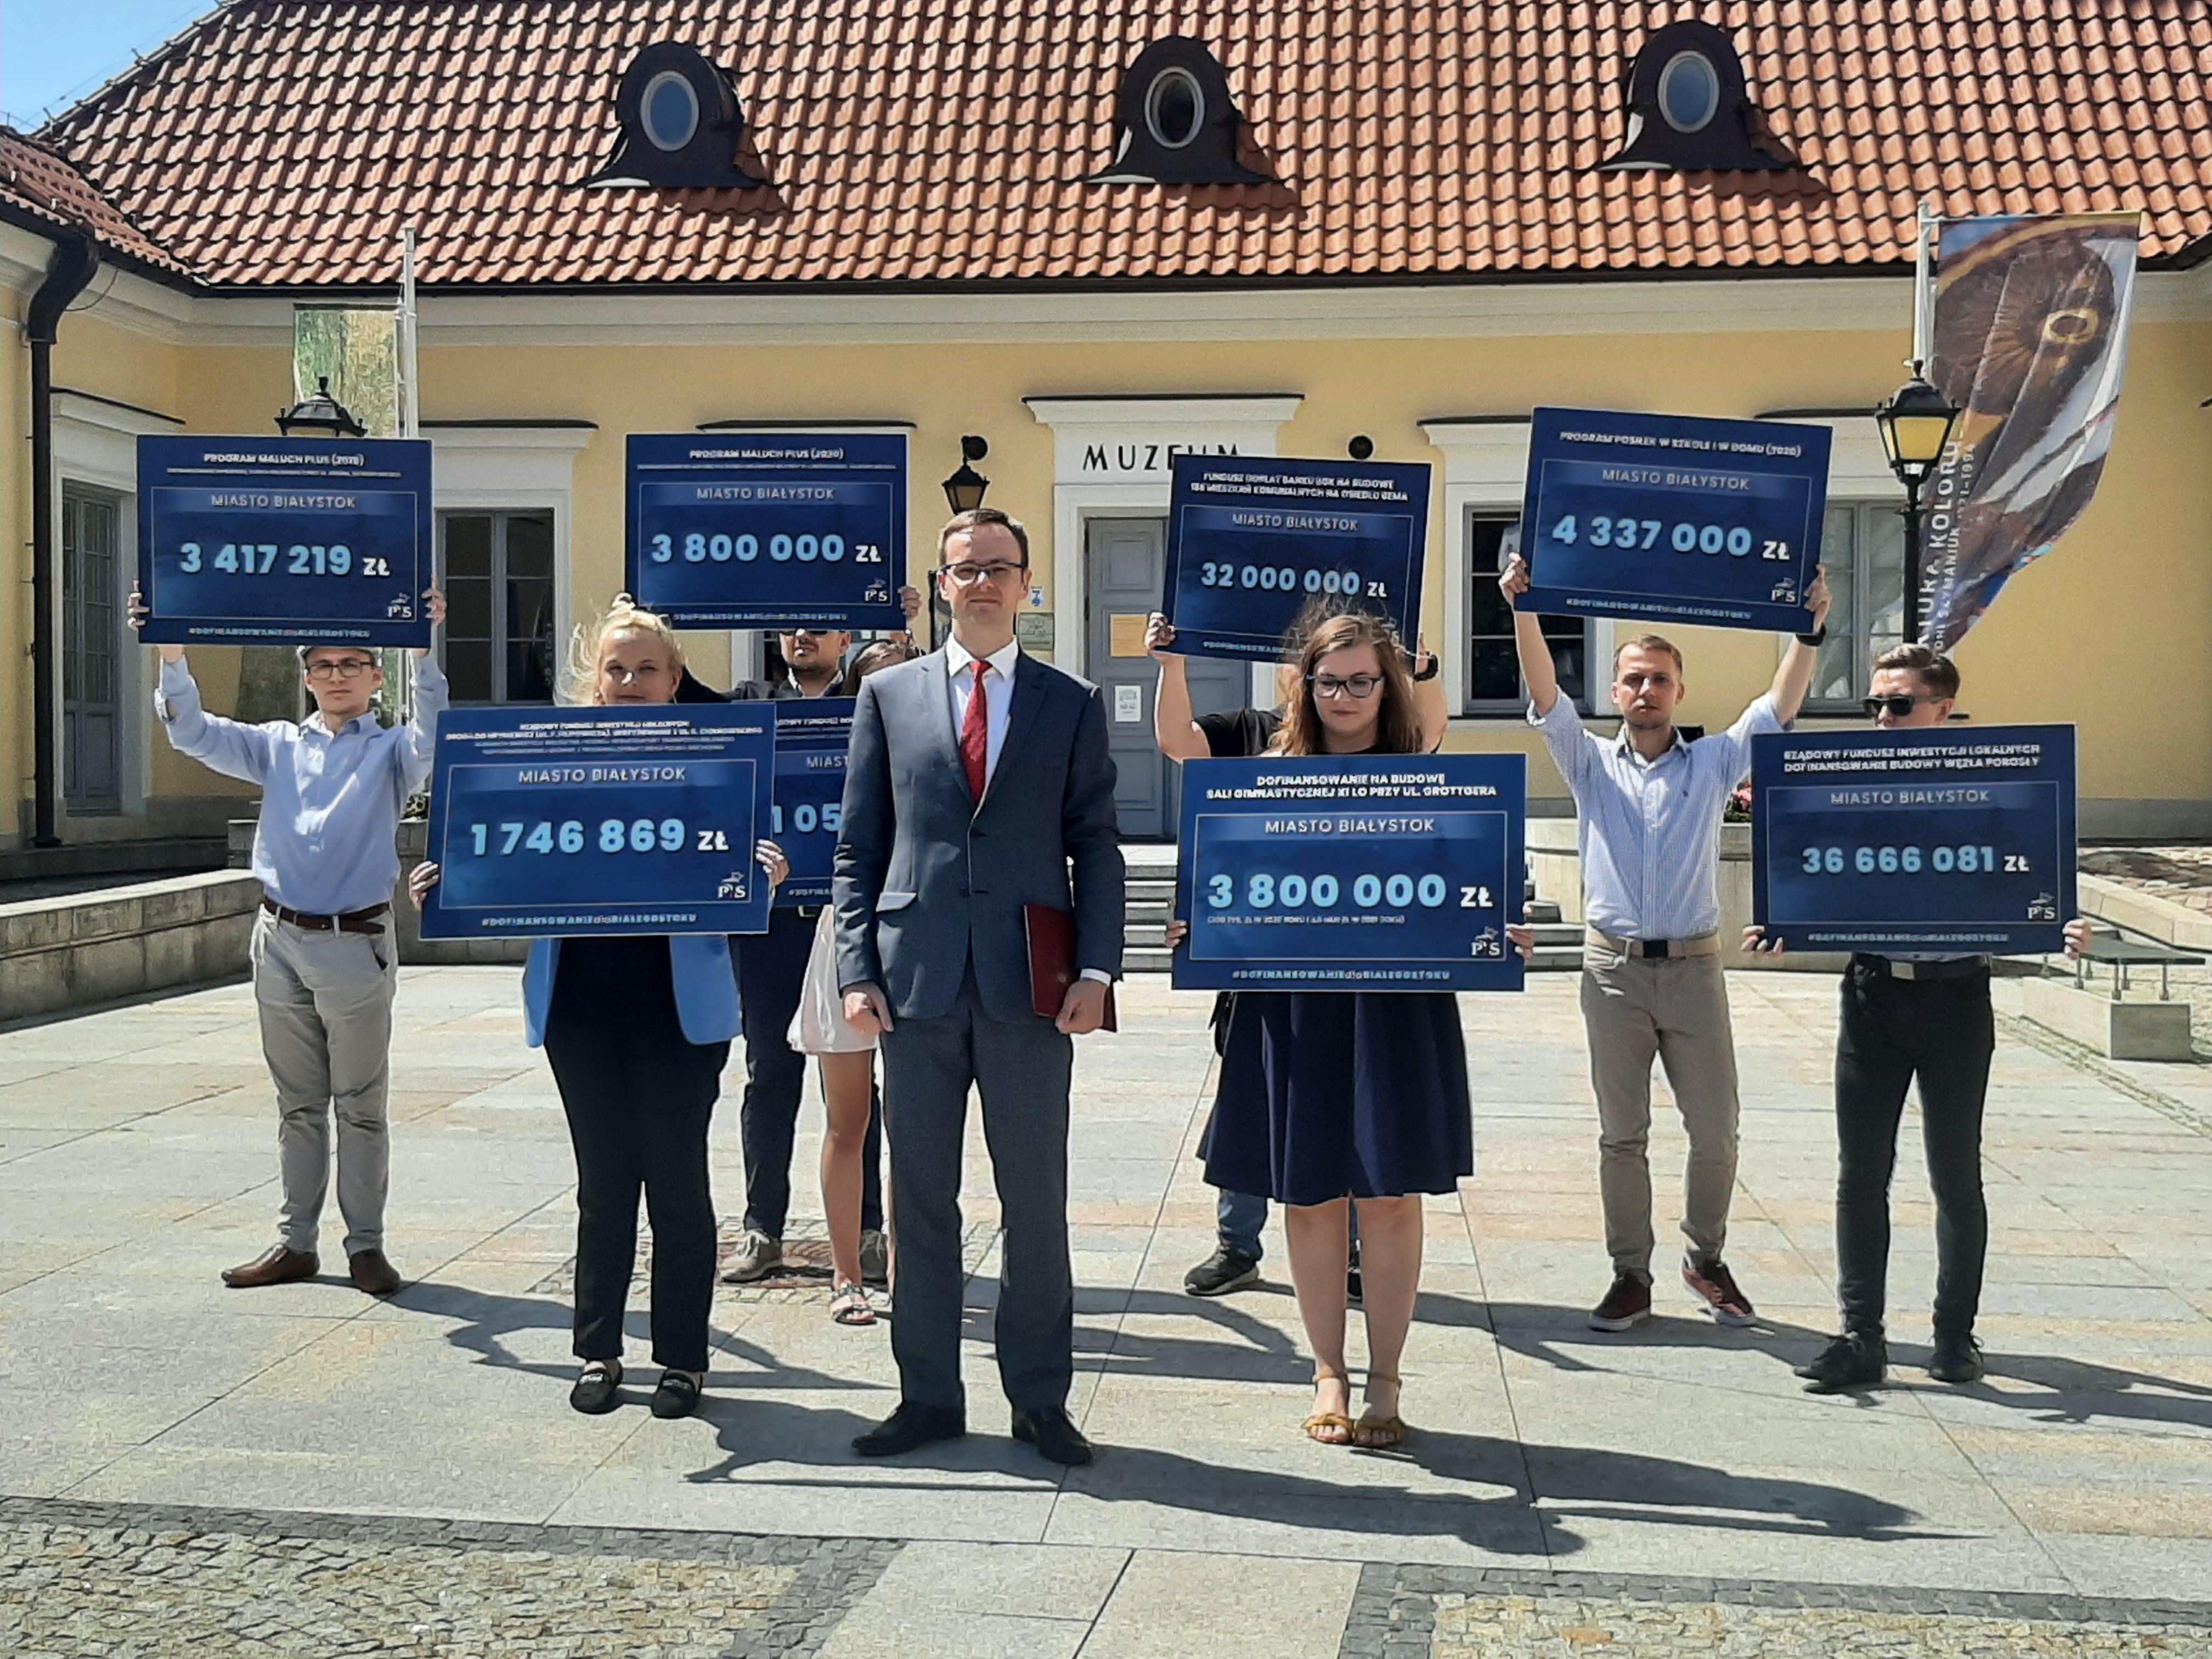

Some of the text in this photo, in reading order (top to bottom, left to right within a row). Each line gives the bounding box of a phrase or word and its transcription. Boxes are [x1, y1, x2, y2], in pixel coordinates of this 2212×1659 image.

[1560, 431, 1613, 443] PROGRAM
[1659, 438, 1670, 447] W
[1718, 441, 1729, 450] W
[1731, 443, 1764, 454] DOMU
[204, 453, 256, 463] PROGRAM
[690, 449, 740, 459] PROGRAM
[1602, 468, 1750, 490] MIASTO BIAŁYSTOK
[211, 494, 356, 509] MIASTO BIAŁYSTOK
[697, 487, 837, 500] MIASTO BIAŁYSTOK
[1928, 442, 1961, 548] KOLORU
[1231, 513, 1359, 532] MIASTO BIAŁYSTOK
[1552, 515, 1577, 544] 4
[1590, 516, 1662, 549] 337
[1672, 523, 1752, 556] 000
[652, 534, 672, 562] 3
[685, 534, 759, 562] 800
[770, 534, 845, 562] 000
[180, 543, 202, 573] 3
[214, 544, 278, 574] 417
[289, 545, 352, 575] 219
[1200, 562, 1234, 588] 32
[1241, 565, 1296, 591] 000
[1304, 569, 1360, 595] 000
[1784, 750, 1840, 761] RZĄDOWY
[1843, 748, 1895, 759] FUNDUSZ
[1968, 744, 2040, 755] LOKALNYCH
[806, 756, 849, 768] MIAST
[1890, 759, 1941, 769] BUDOWY
[518, 766, 686, 783] MIASTO BIAŁYSTOK
[1257, 774, 1445, 786] DOFINANSOWANIE NA BUDOWĘ
[1352, 787, 1367, 797] LO
[1369, 787, 1400, 797] PRZY
[1830, 790, 1990, 806] MIASTO BIAŁYSTOK
[794, 803, 842, 832] 05
[1265, 818, 1435, 834] MIASTO BIAŁYSTOK
[471, 823, 487, 856] 1
[500, 821, 584, 855] 746
[599, 819, 686, 854] 869
[1802, 847, 1844, 874] 36
[1855, 845, 1921, 873] 666
[1932, 845, 1994, 872] 081
[1207, 873, 1233, 909] 3
[1248, 873, 1339, 909] 800
[1353, 873, 1447, 908] 000
